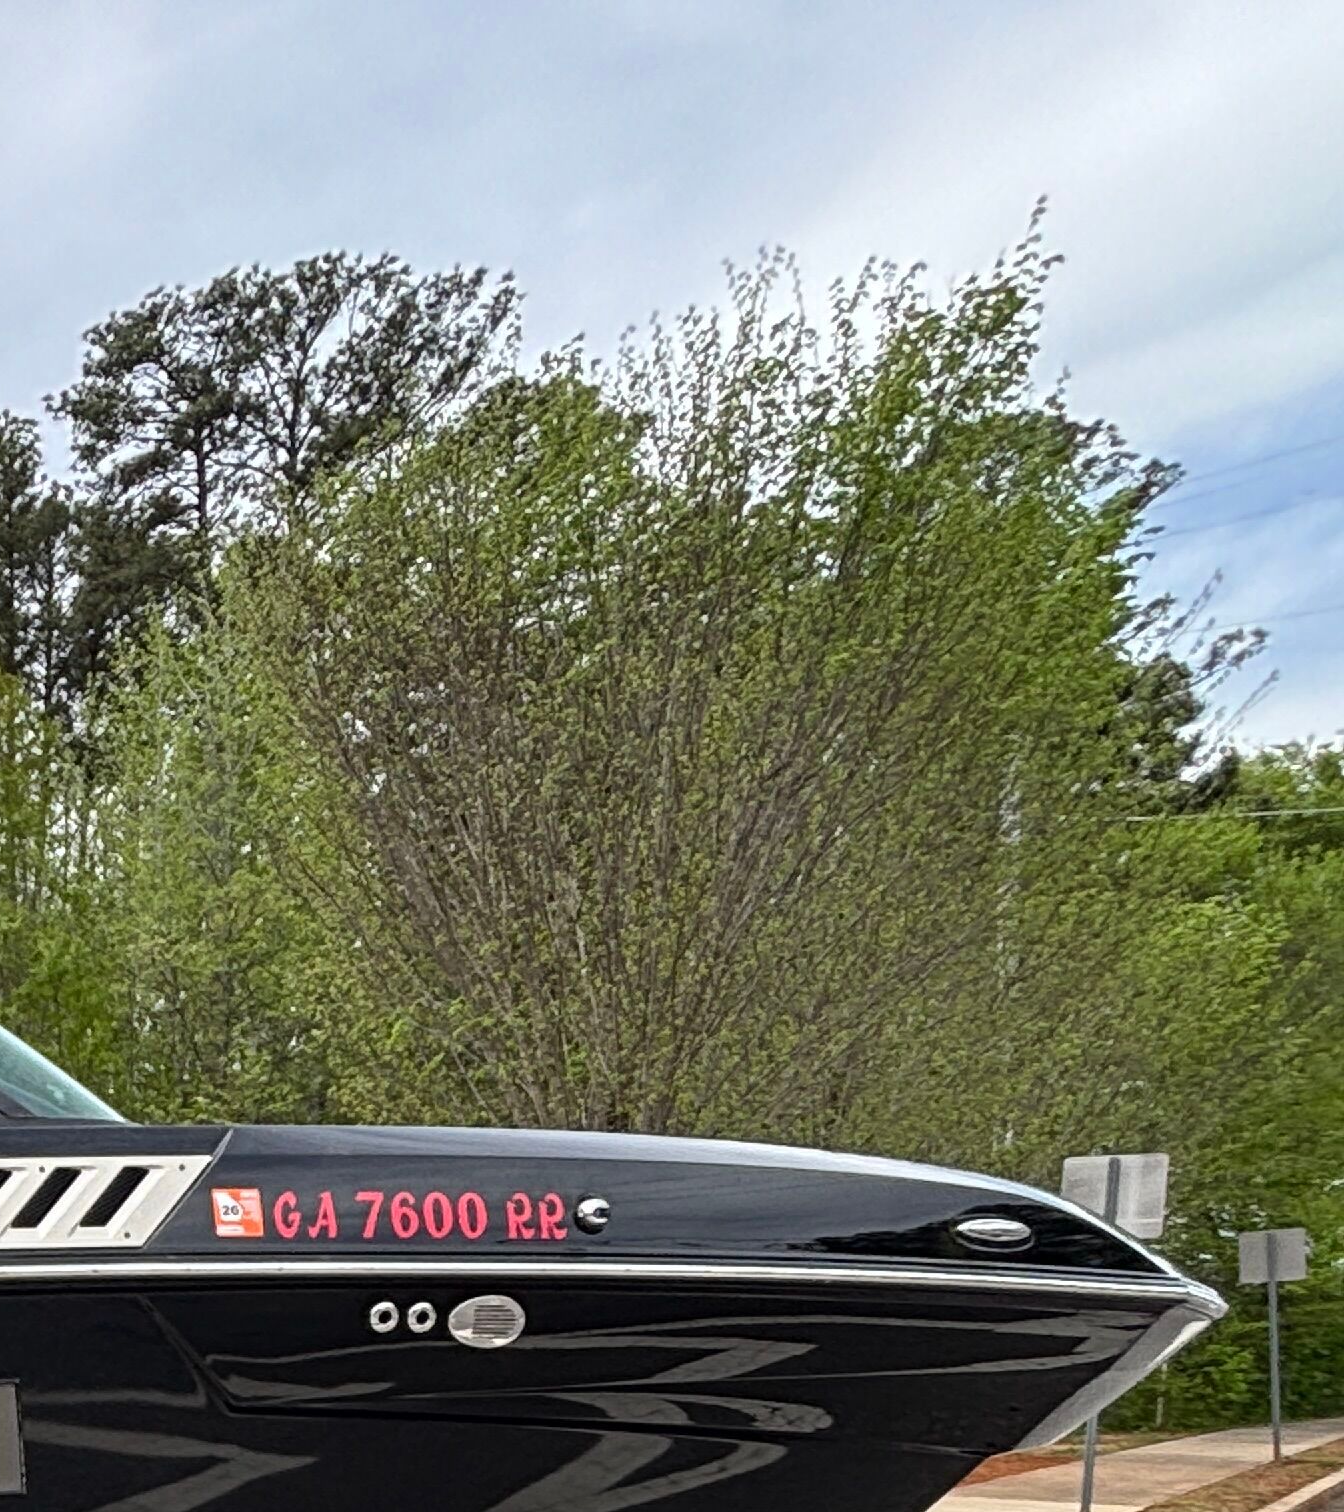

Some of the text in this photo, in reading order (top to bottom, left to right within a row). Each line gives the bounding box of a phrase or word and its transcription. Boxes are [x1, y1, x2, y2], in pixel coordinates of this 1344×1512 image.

[222, 1205, 240, 1216] 26
[273, 1190, 568, 1240] GA 7600 RR
